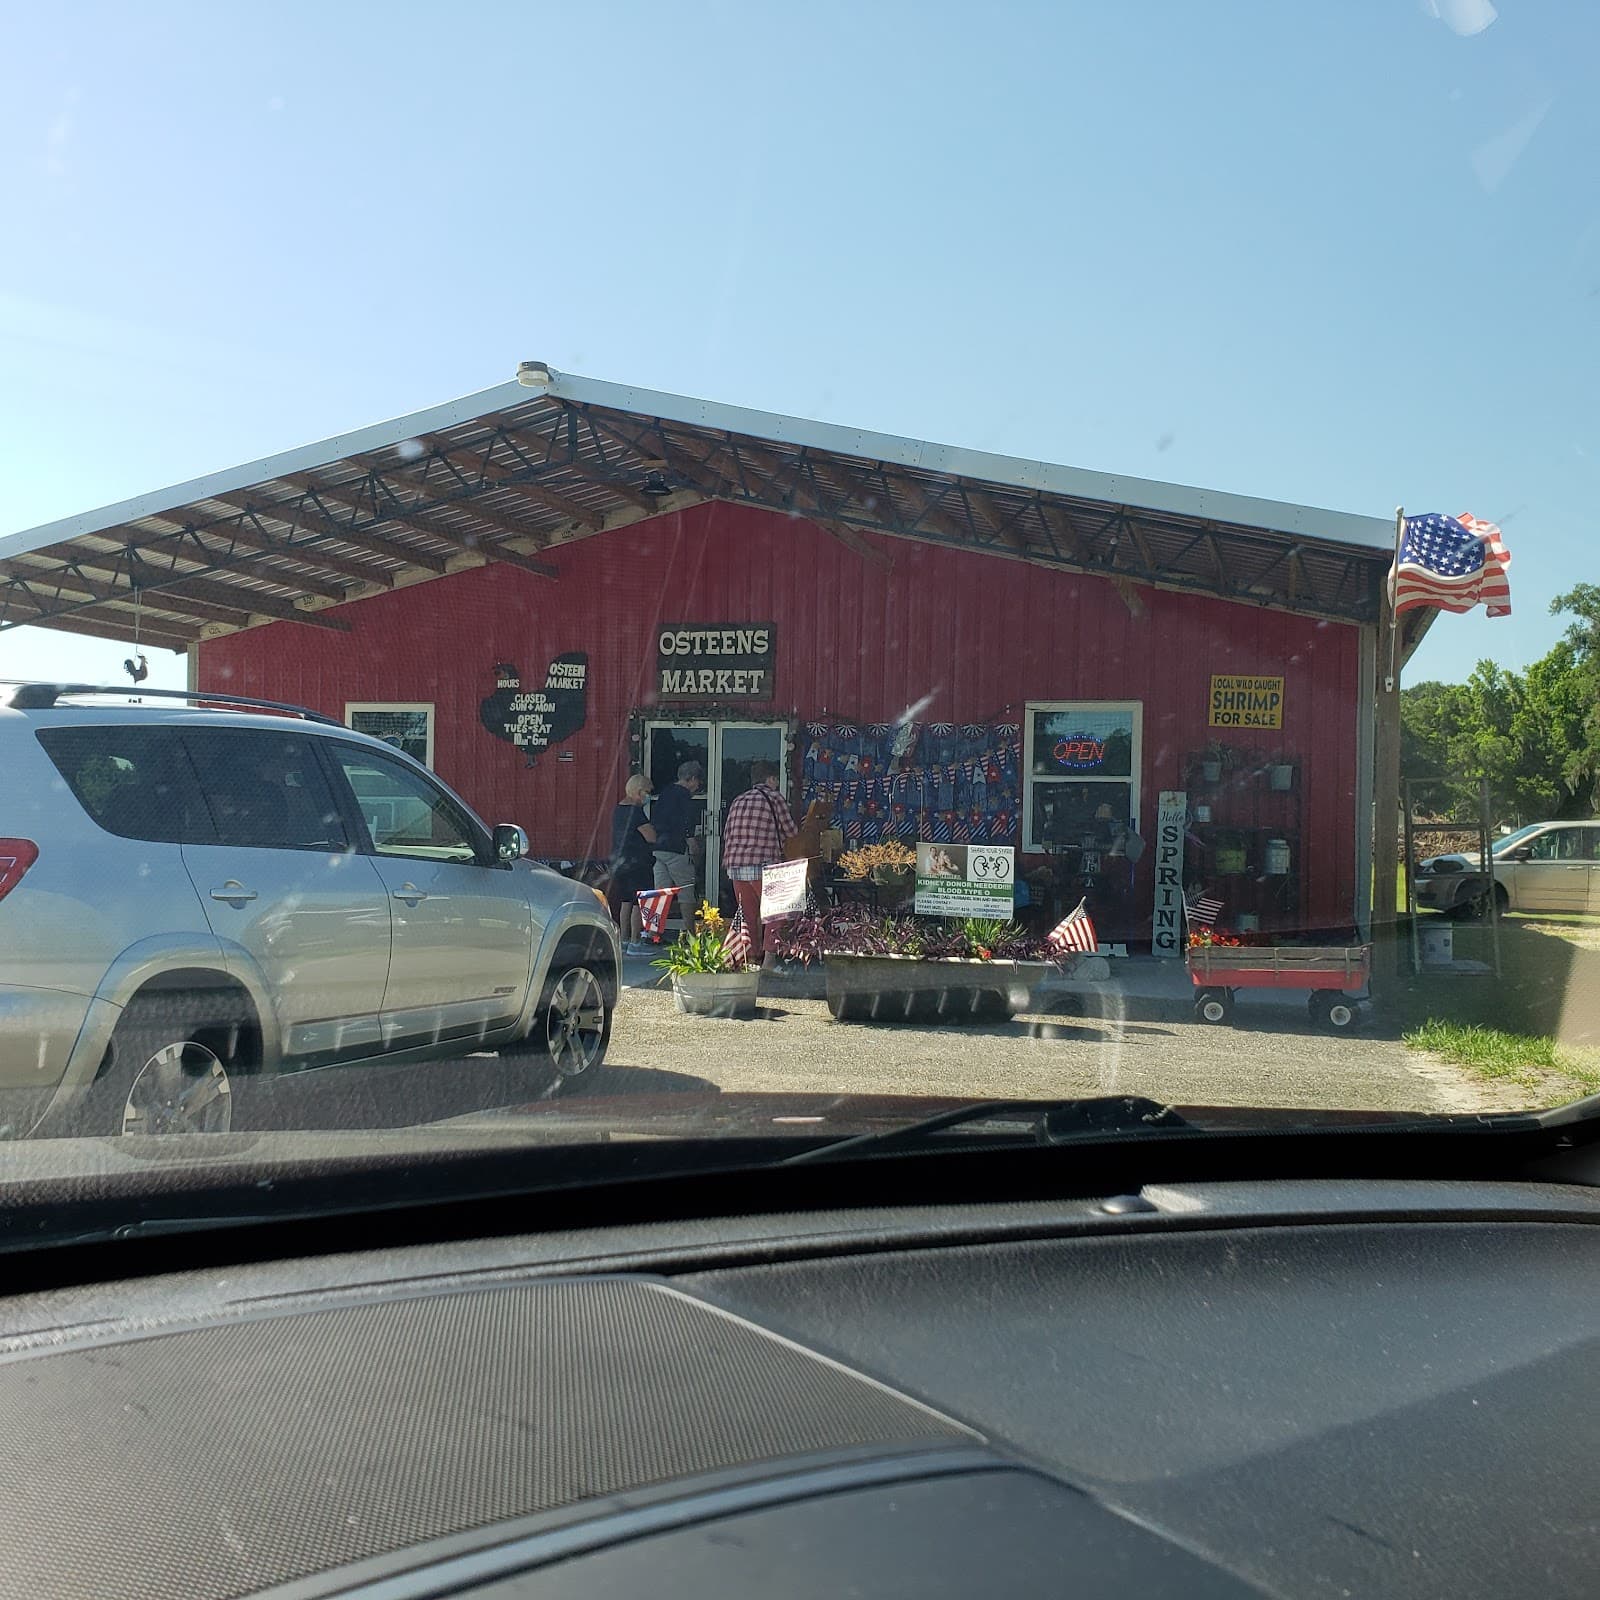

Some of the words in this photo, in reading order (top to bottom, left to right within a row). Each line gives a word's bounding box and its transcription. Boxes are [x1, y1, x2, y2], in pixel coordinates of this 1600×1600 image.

[659, 630, 769, 655] OSTEENS
[549, 662, 586, 677] OSTEEN
[497, 679, 520, 688] HOURS
[545, 677, 586, 689] MARKET
[661, 669, 765, 694] MARKET
[1213, 678, 1234, 689] LOCAL
[1236, 679, 1253, 689] WILD
[1254, 679, 1281, 690] CAUGHT
[514, 694, 547, 703] CLOSED
[1213, 690, 1280, 711] SHRIMP
[509, 703, 528, 712] SUN
[534, 703, 556, 713] MON
[517, 714, 544, 725] OPEN
[1214, 712, 1241, 724] FOR
[1244, 713, 1276, 725] SALE
[504, 724, 553, 733] TUES-SAT
[1053, 742, 1105, 760] OPEN
[946, 880, 972, 888] DONOR
[1155, 825, 1179, 950] SPRING
